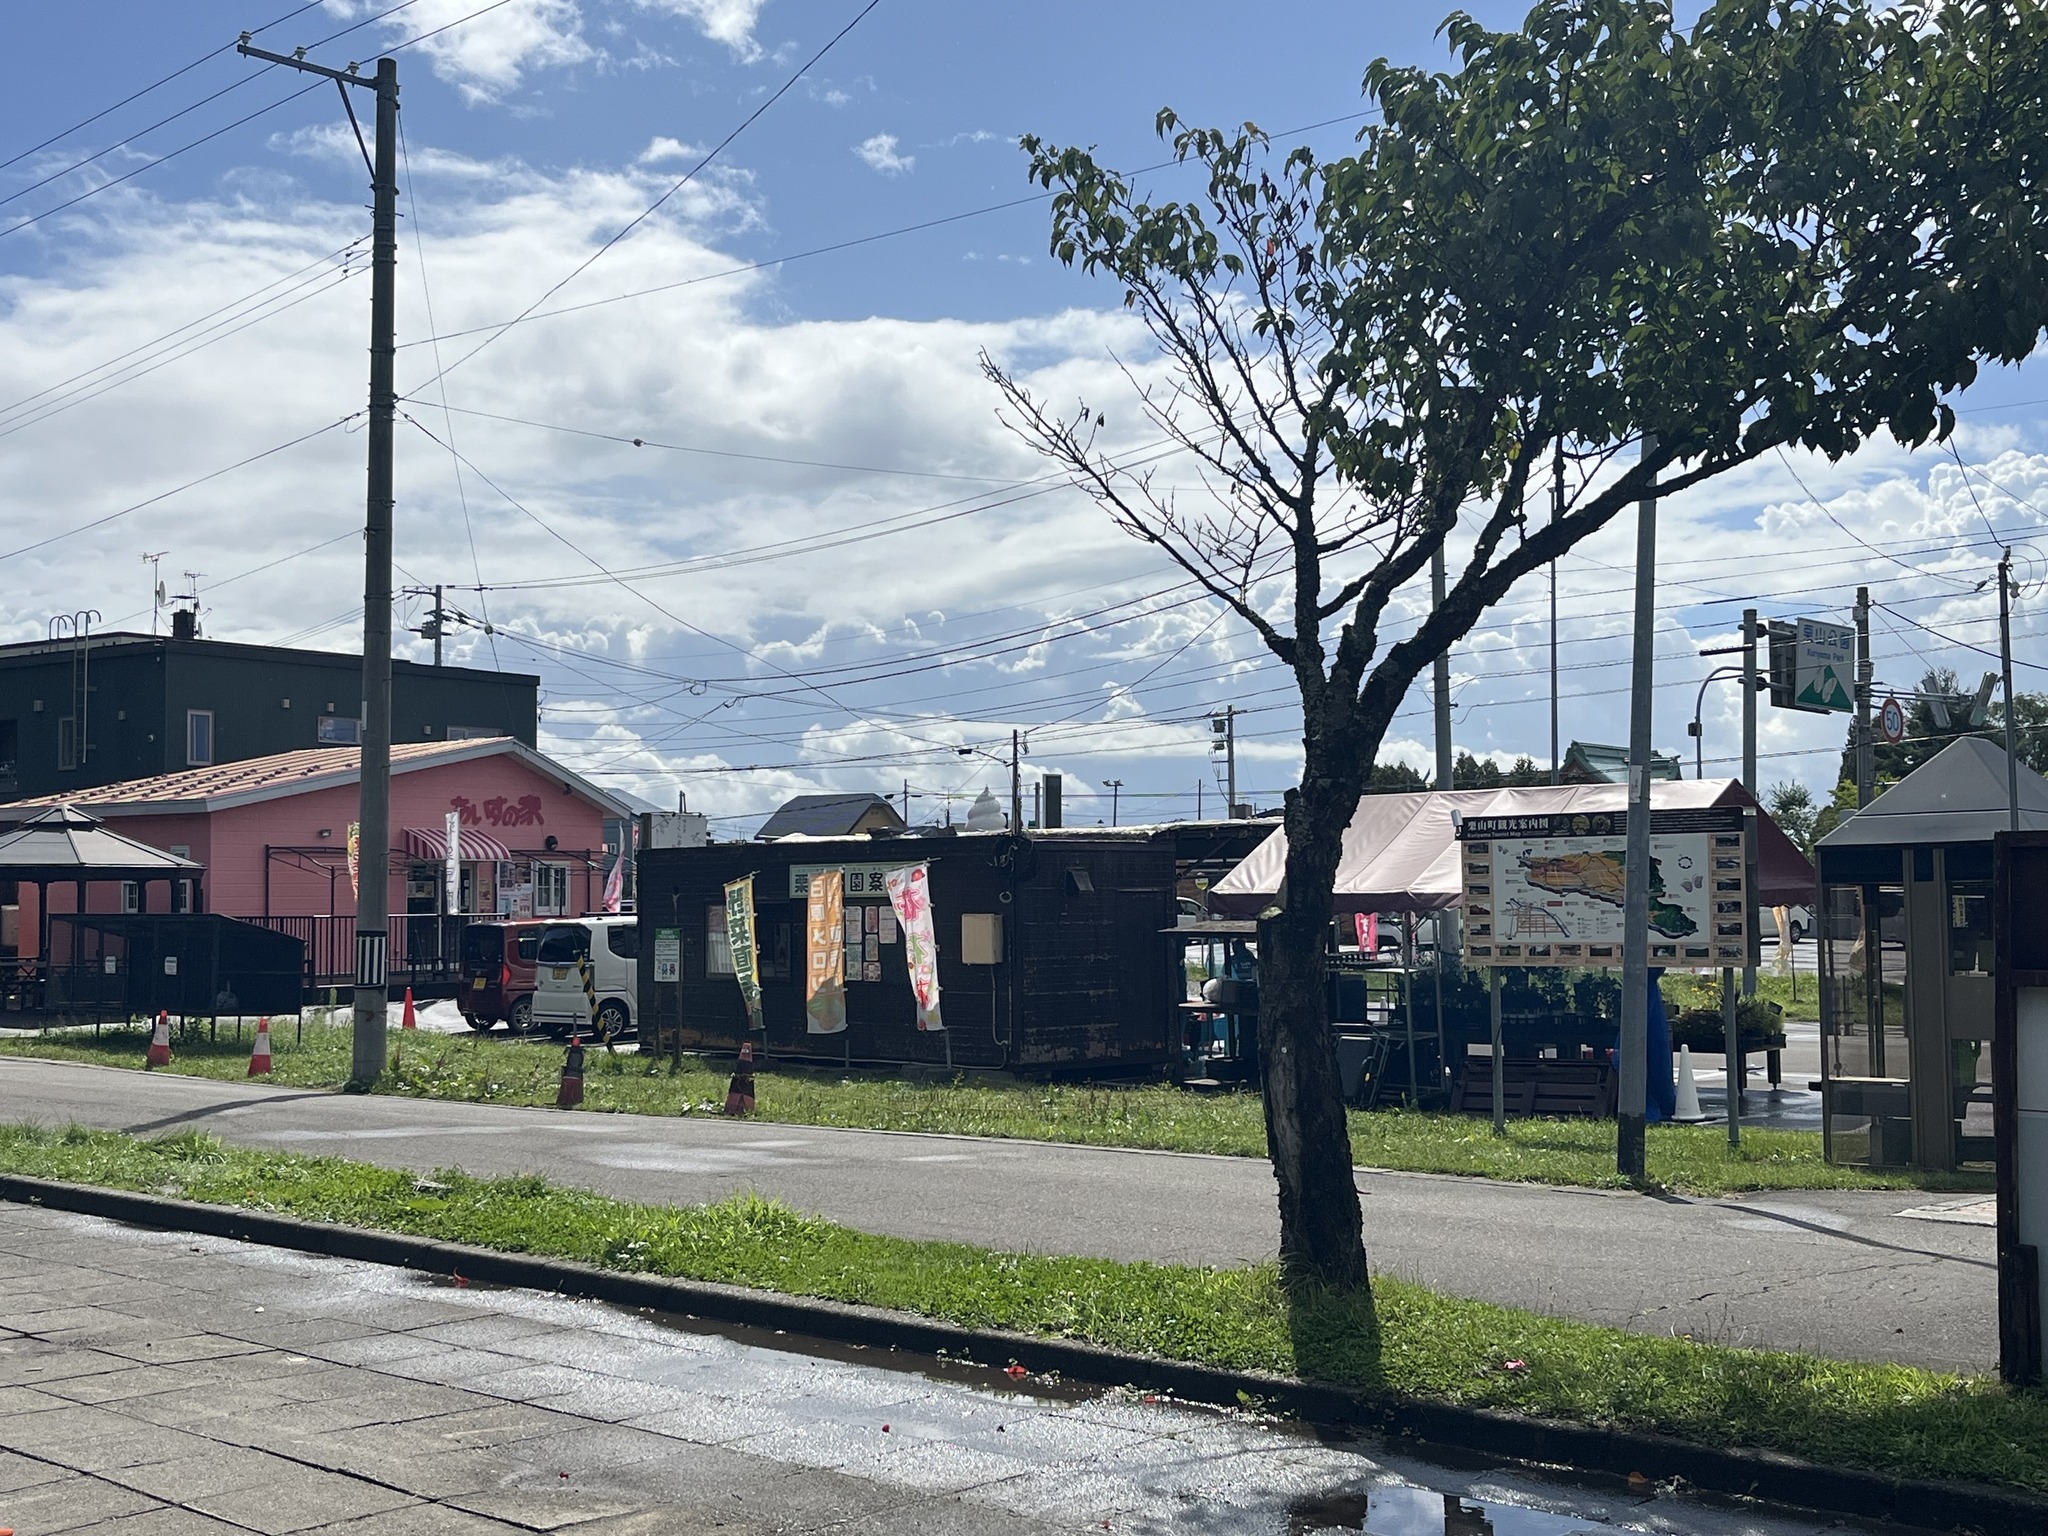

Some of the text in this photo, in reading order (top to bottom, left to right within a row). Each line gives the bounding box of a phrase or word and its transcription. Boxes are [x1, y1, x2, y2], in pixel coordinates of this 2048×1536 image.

[1833, 652, 1845, 661] Park
[1887, 710, 1899, 731] 50
[450, 794, 545, 827] あいすの家
[1467, 818, 1549, 831] 栗山町観光案内図
